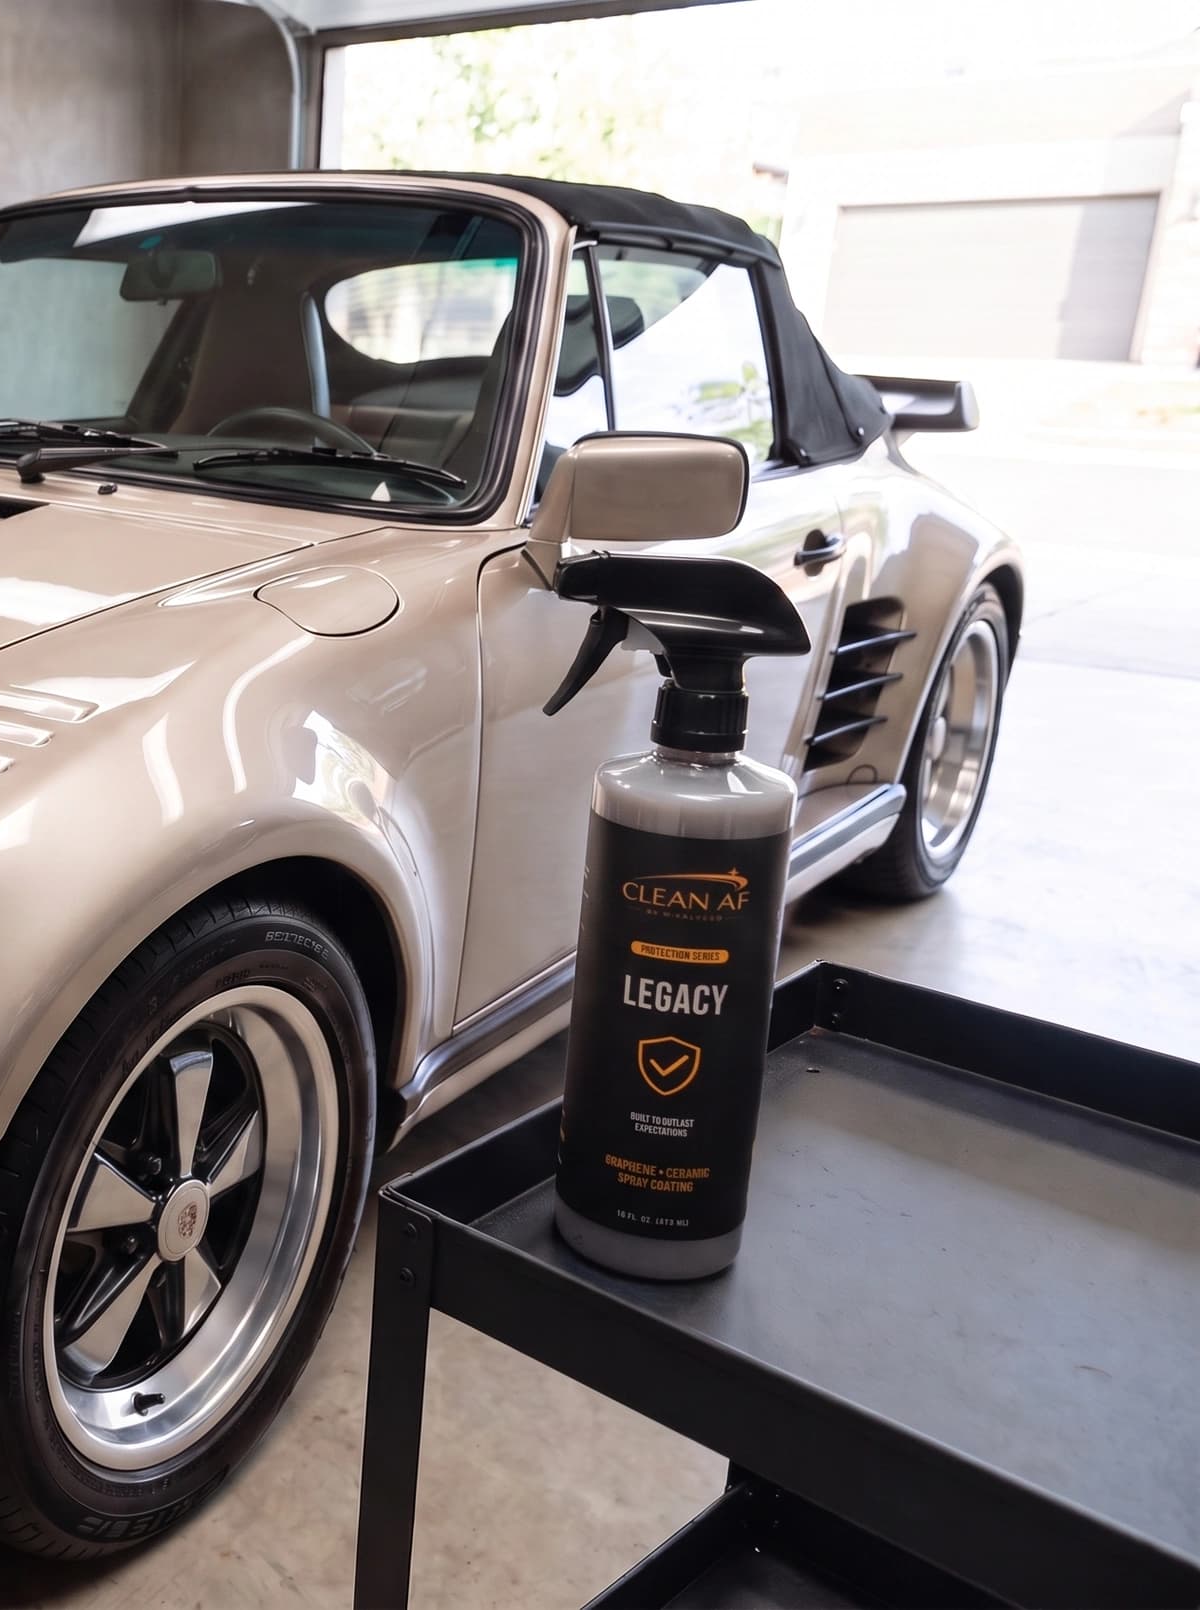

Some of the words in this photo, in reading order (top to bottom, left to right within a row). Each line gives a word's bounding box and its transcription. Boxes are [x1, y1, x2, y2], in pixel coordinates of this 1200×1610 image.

[622, 881, 709, 910] CLEAN
[716, 890, 751, 911] AF
[640, 944, 690, 961] PROTECTION
[692, 951, 721, 961] SERIES
[623, 974, 729, 1016] LEGACY
[630, 1111, 651, 1123] BUILT
[652, 1115, 661, 1125] TO
[662, 1117, 695, 1128] OUTLAST
[634, 1122, 688, 1137] EXPECTATIONS
[605, 1153, 657, 1176] GRAPHENE
[665, 1167, 710, 1179] CERAMIC
[617, 1172, 649, 1188] SPRAY
[650, 1179, 694, 1192] COATING
